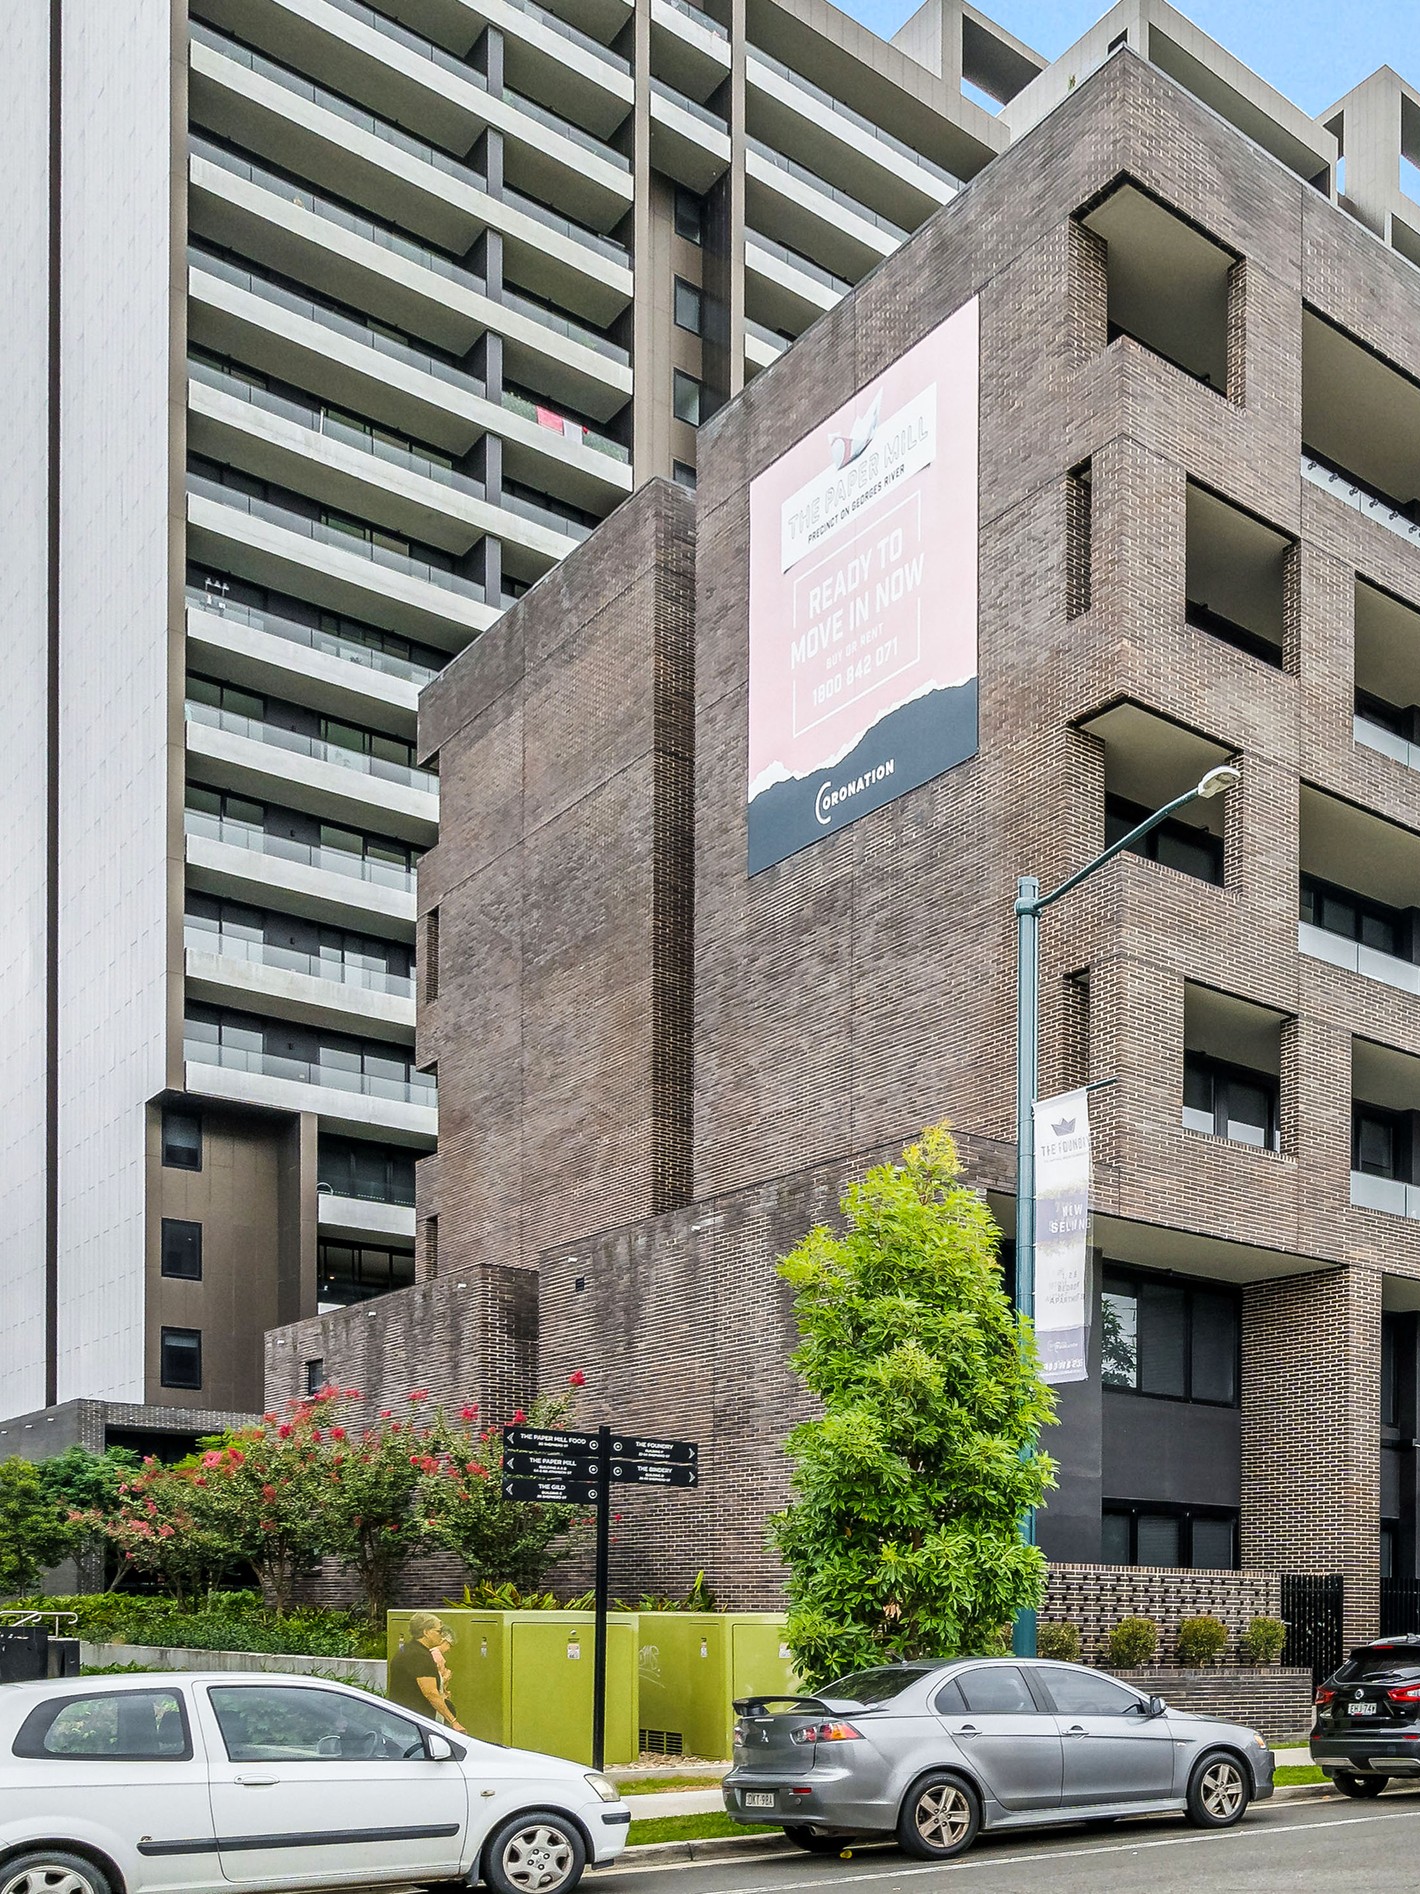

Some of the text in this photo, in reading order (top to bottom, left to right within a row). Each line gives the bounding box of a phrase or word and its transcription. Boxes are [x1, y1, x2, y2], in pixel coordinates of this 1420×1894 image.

[807, 464, 905, 543] PRECINCT ON GEORGES RIVER
[809, 527, 903, 619] READY TO
[790, 552, 924, 670] MOVE IN NOW
[825, 622, 884, 669] BUY OR RENT
[812, 636, 898, 706] 1800 842 071
[814, 758, 896, 825] CORONATION
[534, 1434, 554, 1442] PAPER
[569, 1437, 586, 1445] FOOD
